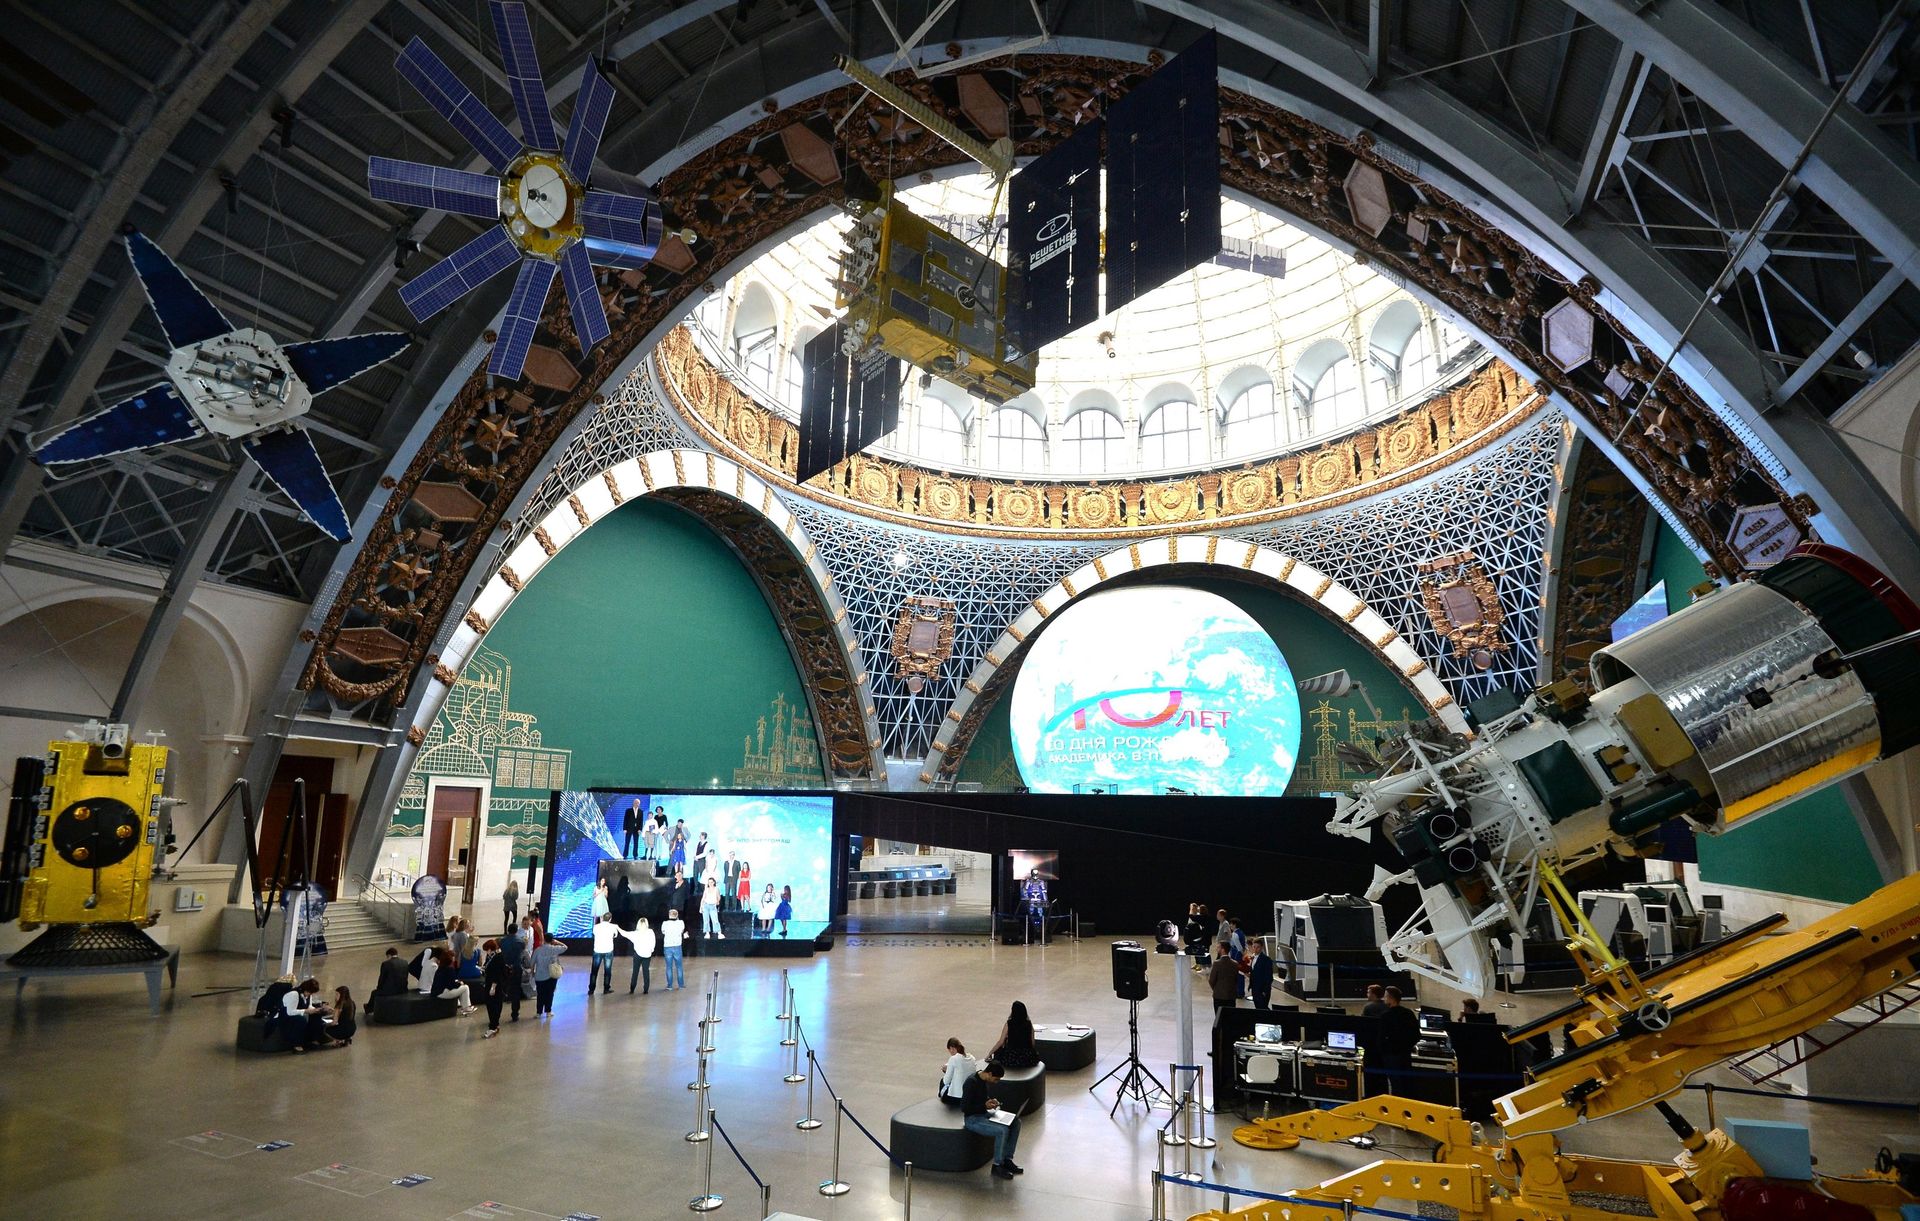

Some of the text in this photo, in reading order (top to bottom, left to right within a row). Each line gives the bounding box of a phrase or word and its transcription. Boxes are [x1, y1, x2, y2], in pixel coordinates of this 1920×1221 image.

[1030, 229, 1077, 263] РЕШЕТНЕВ
[1175, 710, 1231, 728] ЛЕТ
[1070, 737, 1107, 752] ДНЯ
